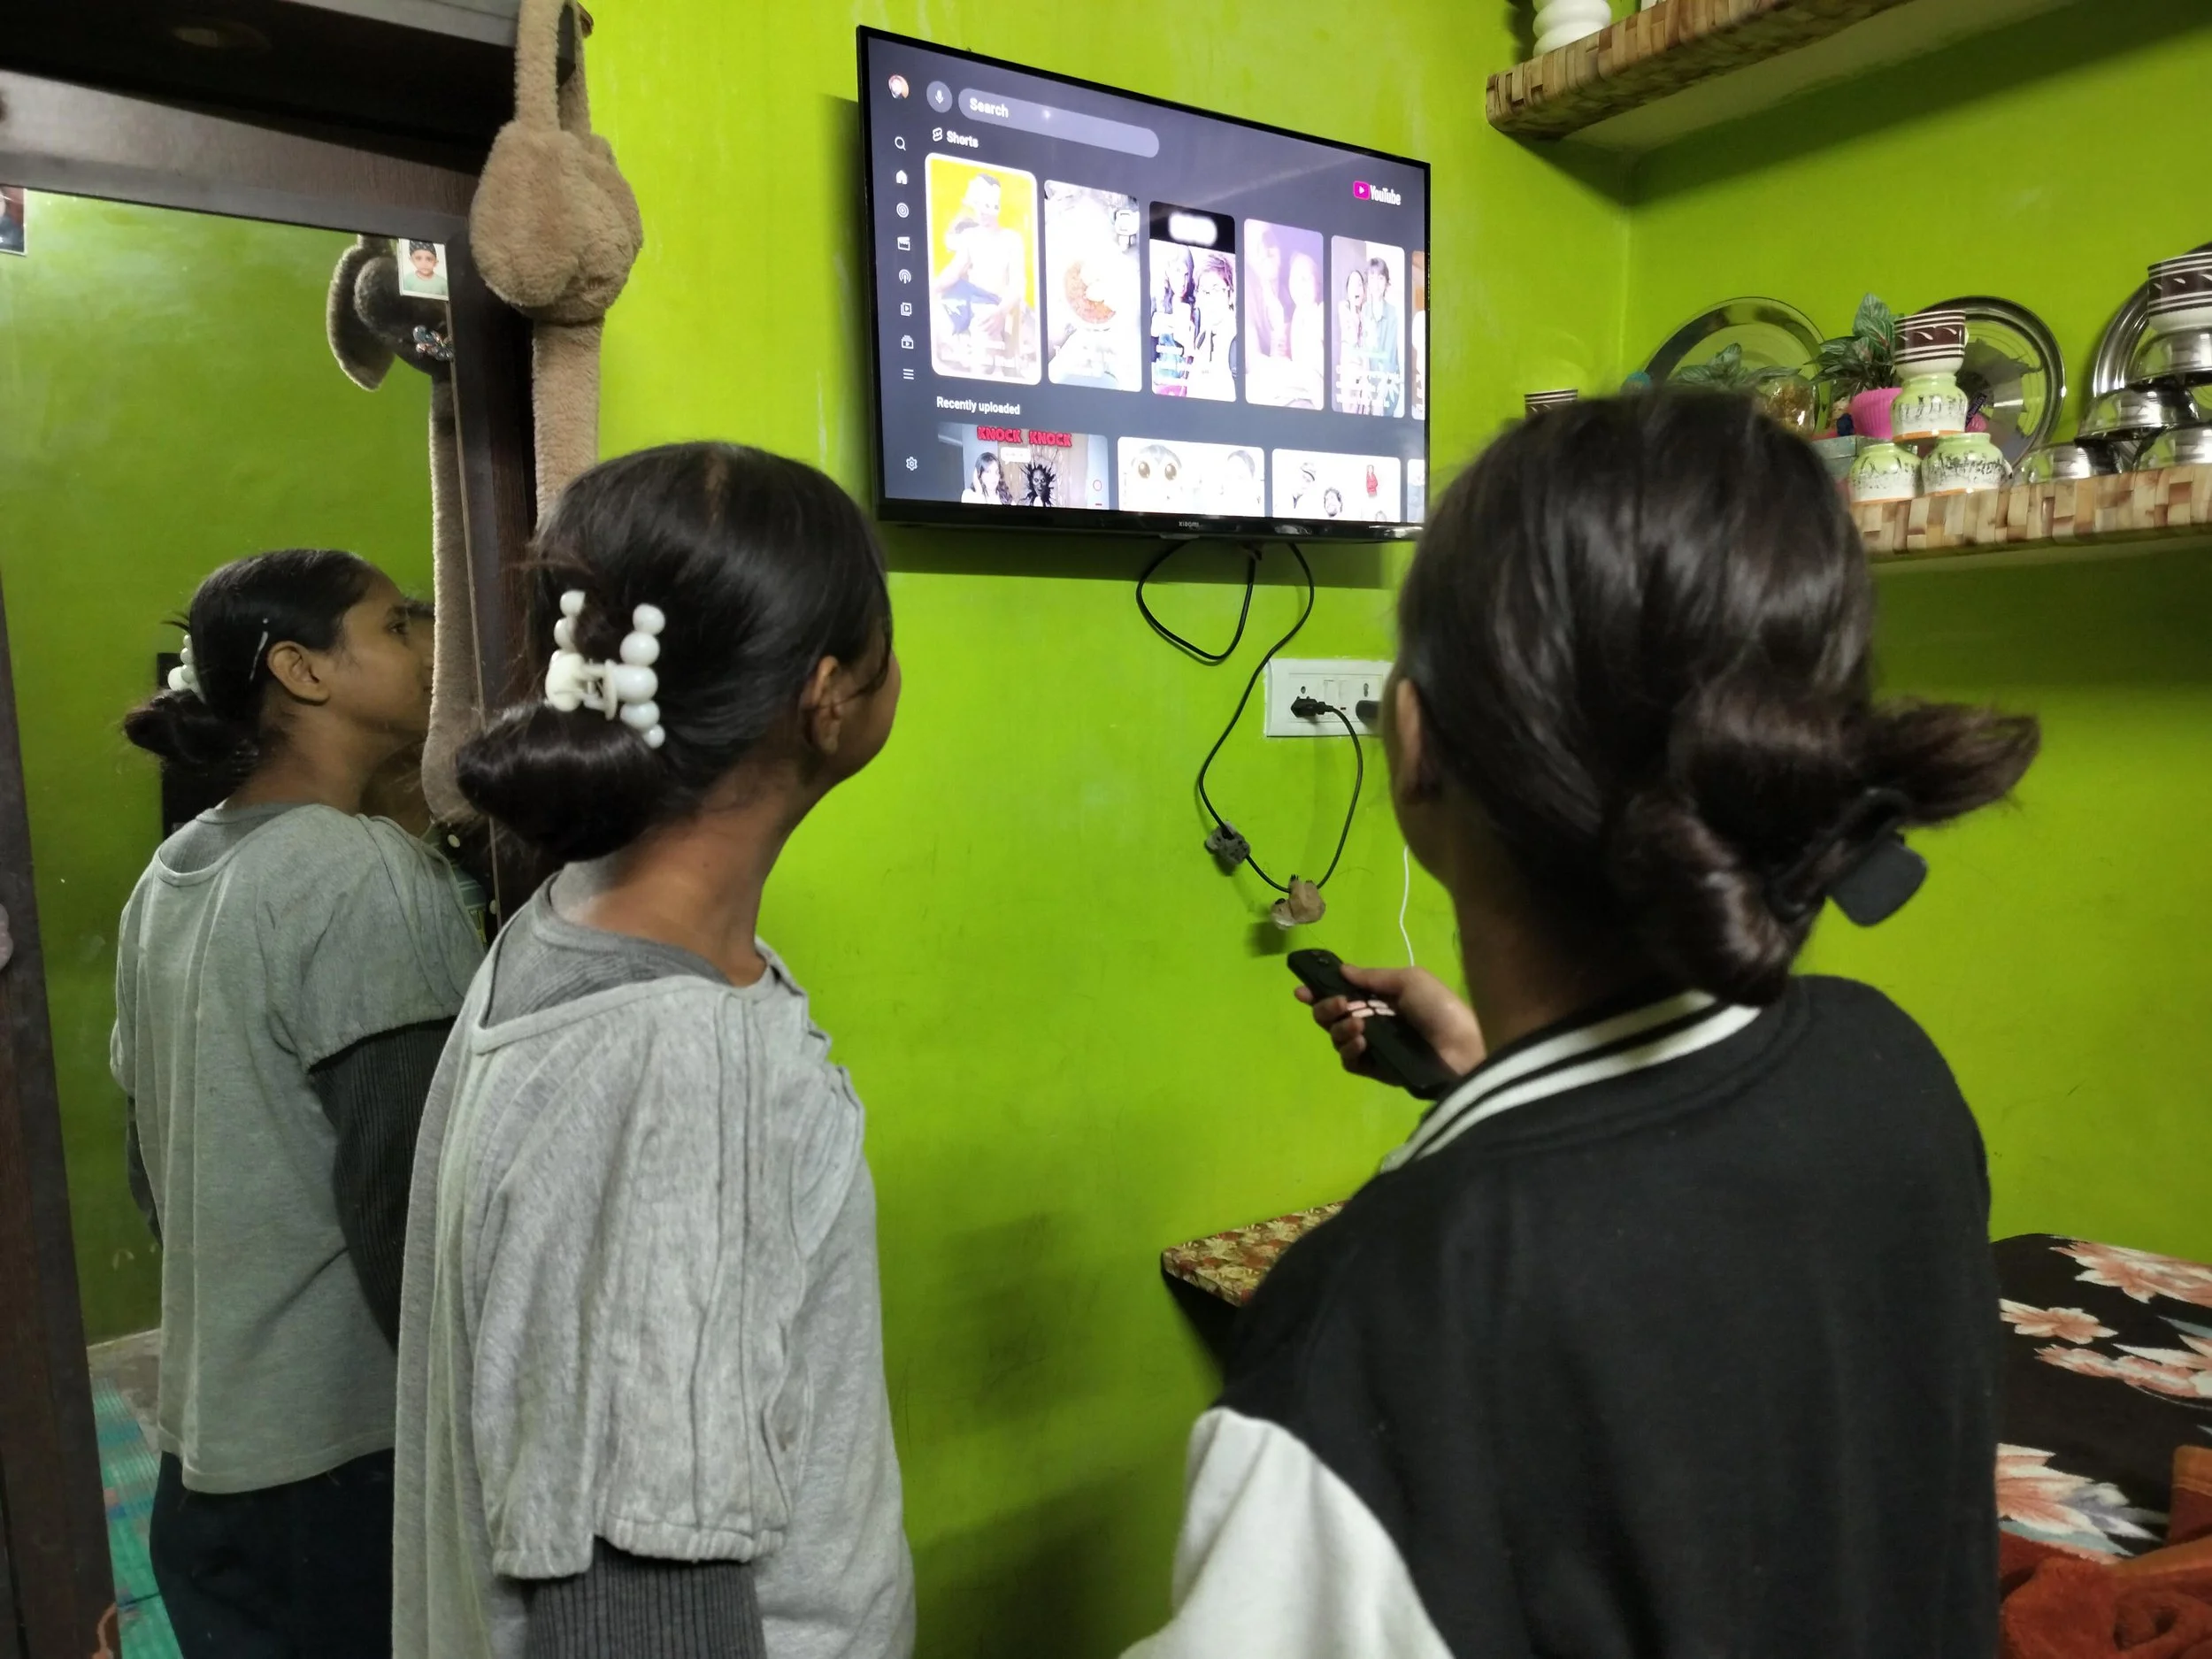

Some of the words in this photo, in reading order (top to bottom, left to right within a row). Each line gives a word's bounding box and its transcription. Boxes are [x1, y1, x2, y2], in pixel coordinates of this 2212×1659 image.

[970, 97, 1009, 118] Search
[946, 130, 979, 148] Shorts
[1369, 184, 1402, 205] YouTube
[936, 396, 977, 413] Recently
[978, 401, 1021, 415] uploaded
[977, 426, 1023, 443] KNOCK
[1029, 429, 1072, 448] KNOCK
